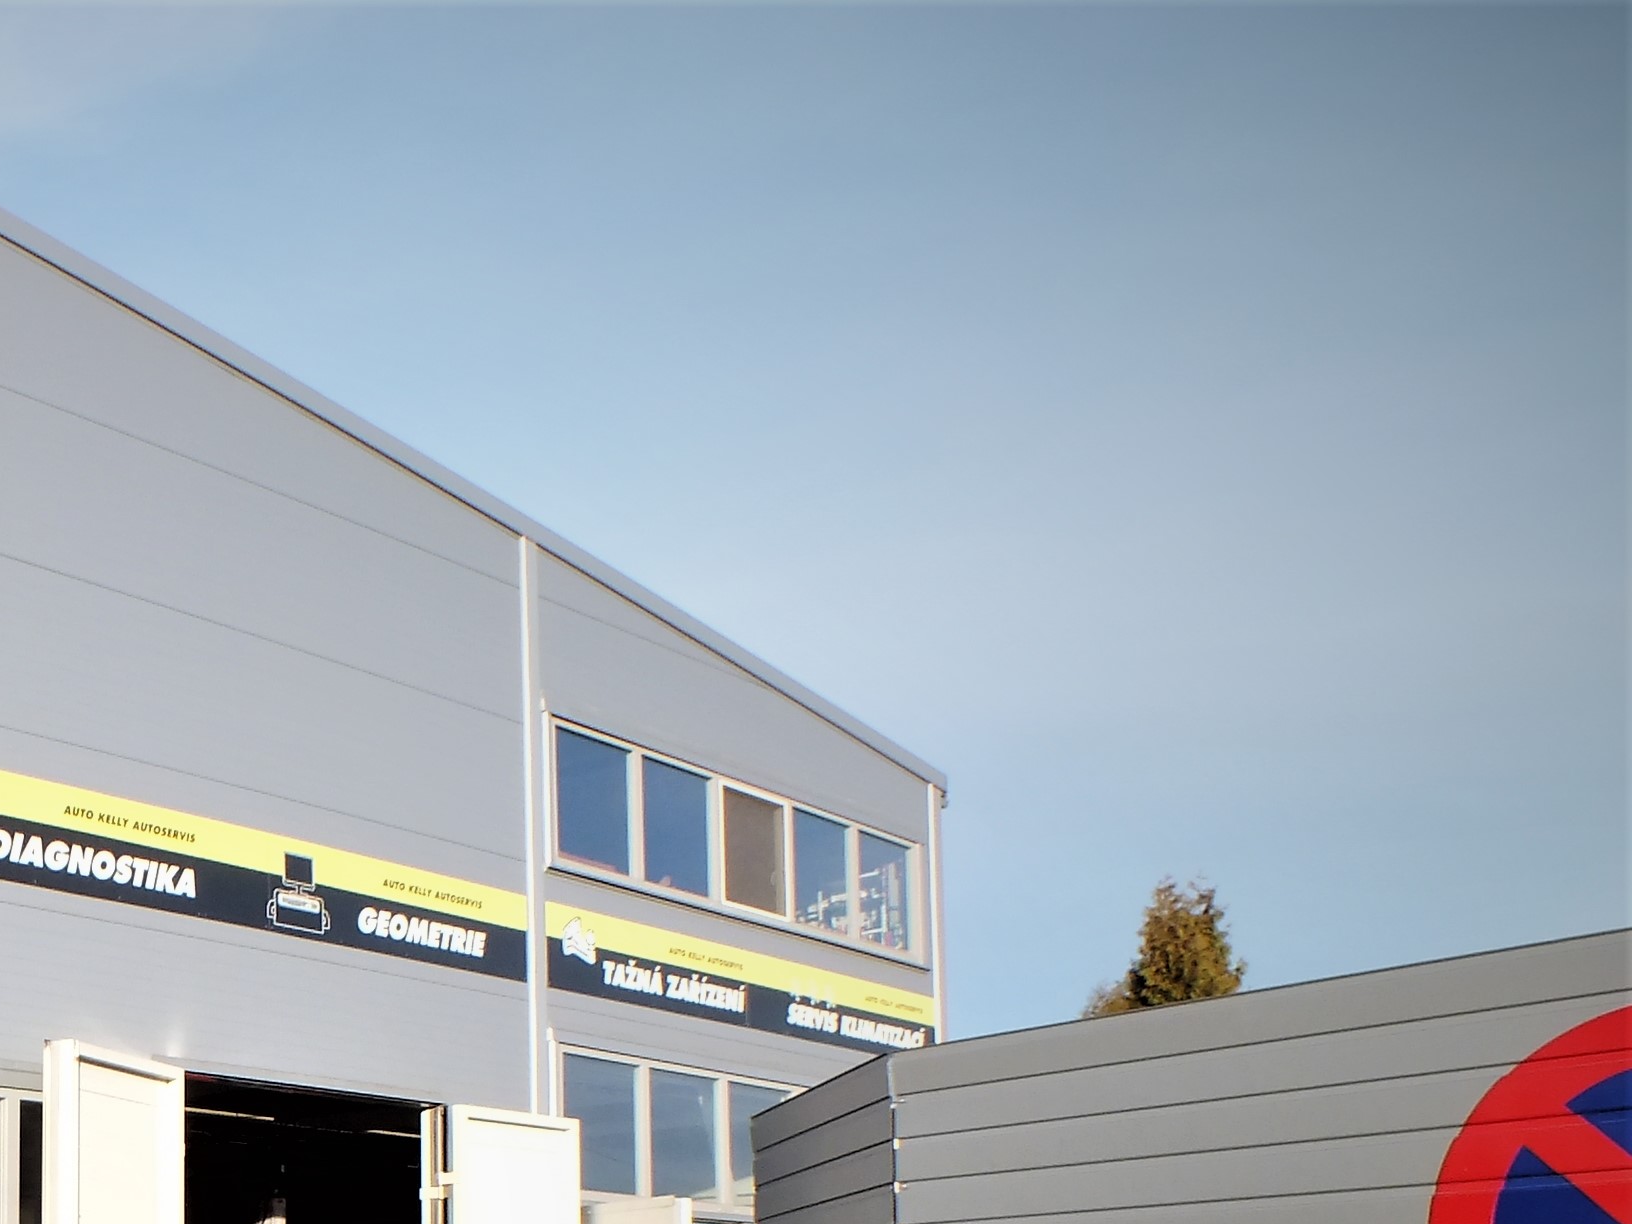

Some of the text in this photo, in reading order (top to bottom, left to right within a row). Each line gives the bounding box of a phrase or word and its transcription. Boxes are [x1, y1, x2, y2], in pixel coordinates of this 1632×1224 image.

[64, 805, 196, 843] AUTO KELLY AUTOSERVIS
[383, 878, 484, 909] AUTO KELLY AUTOSERVIS
[357, 906, 488, 958] GEOMETRIE
[602, 959, 747, 1013] TAŽNÁ ZAŘÍZENÍ
[786, 1003, 839, 1034] SERVIS
